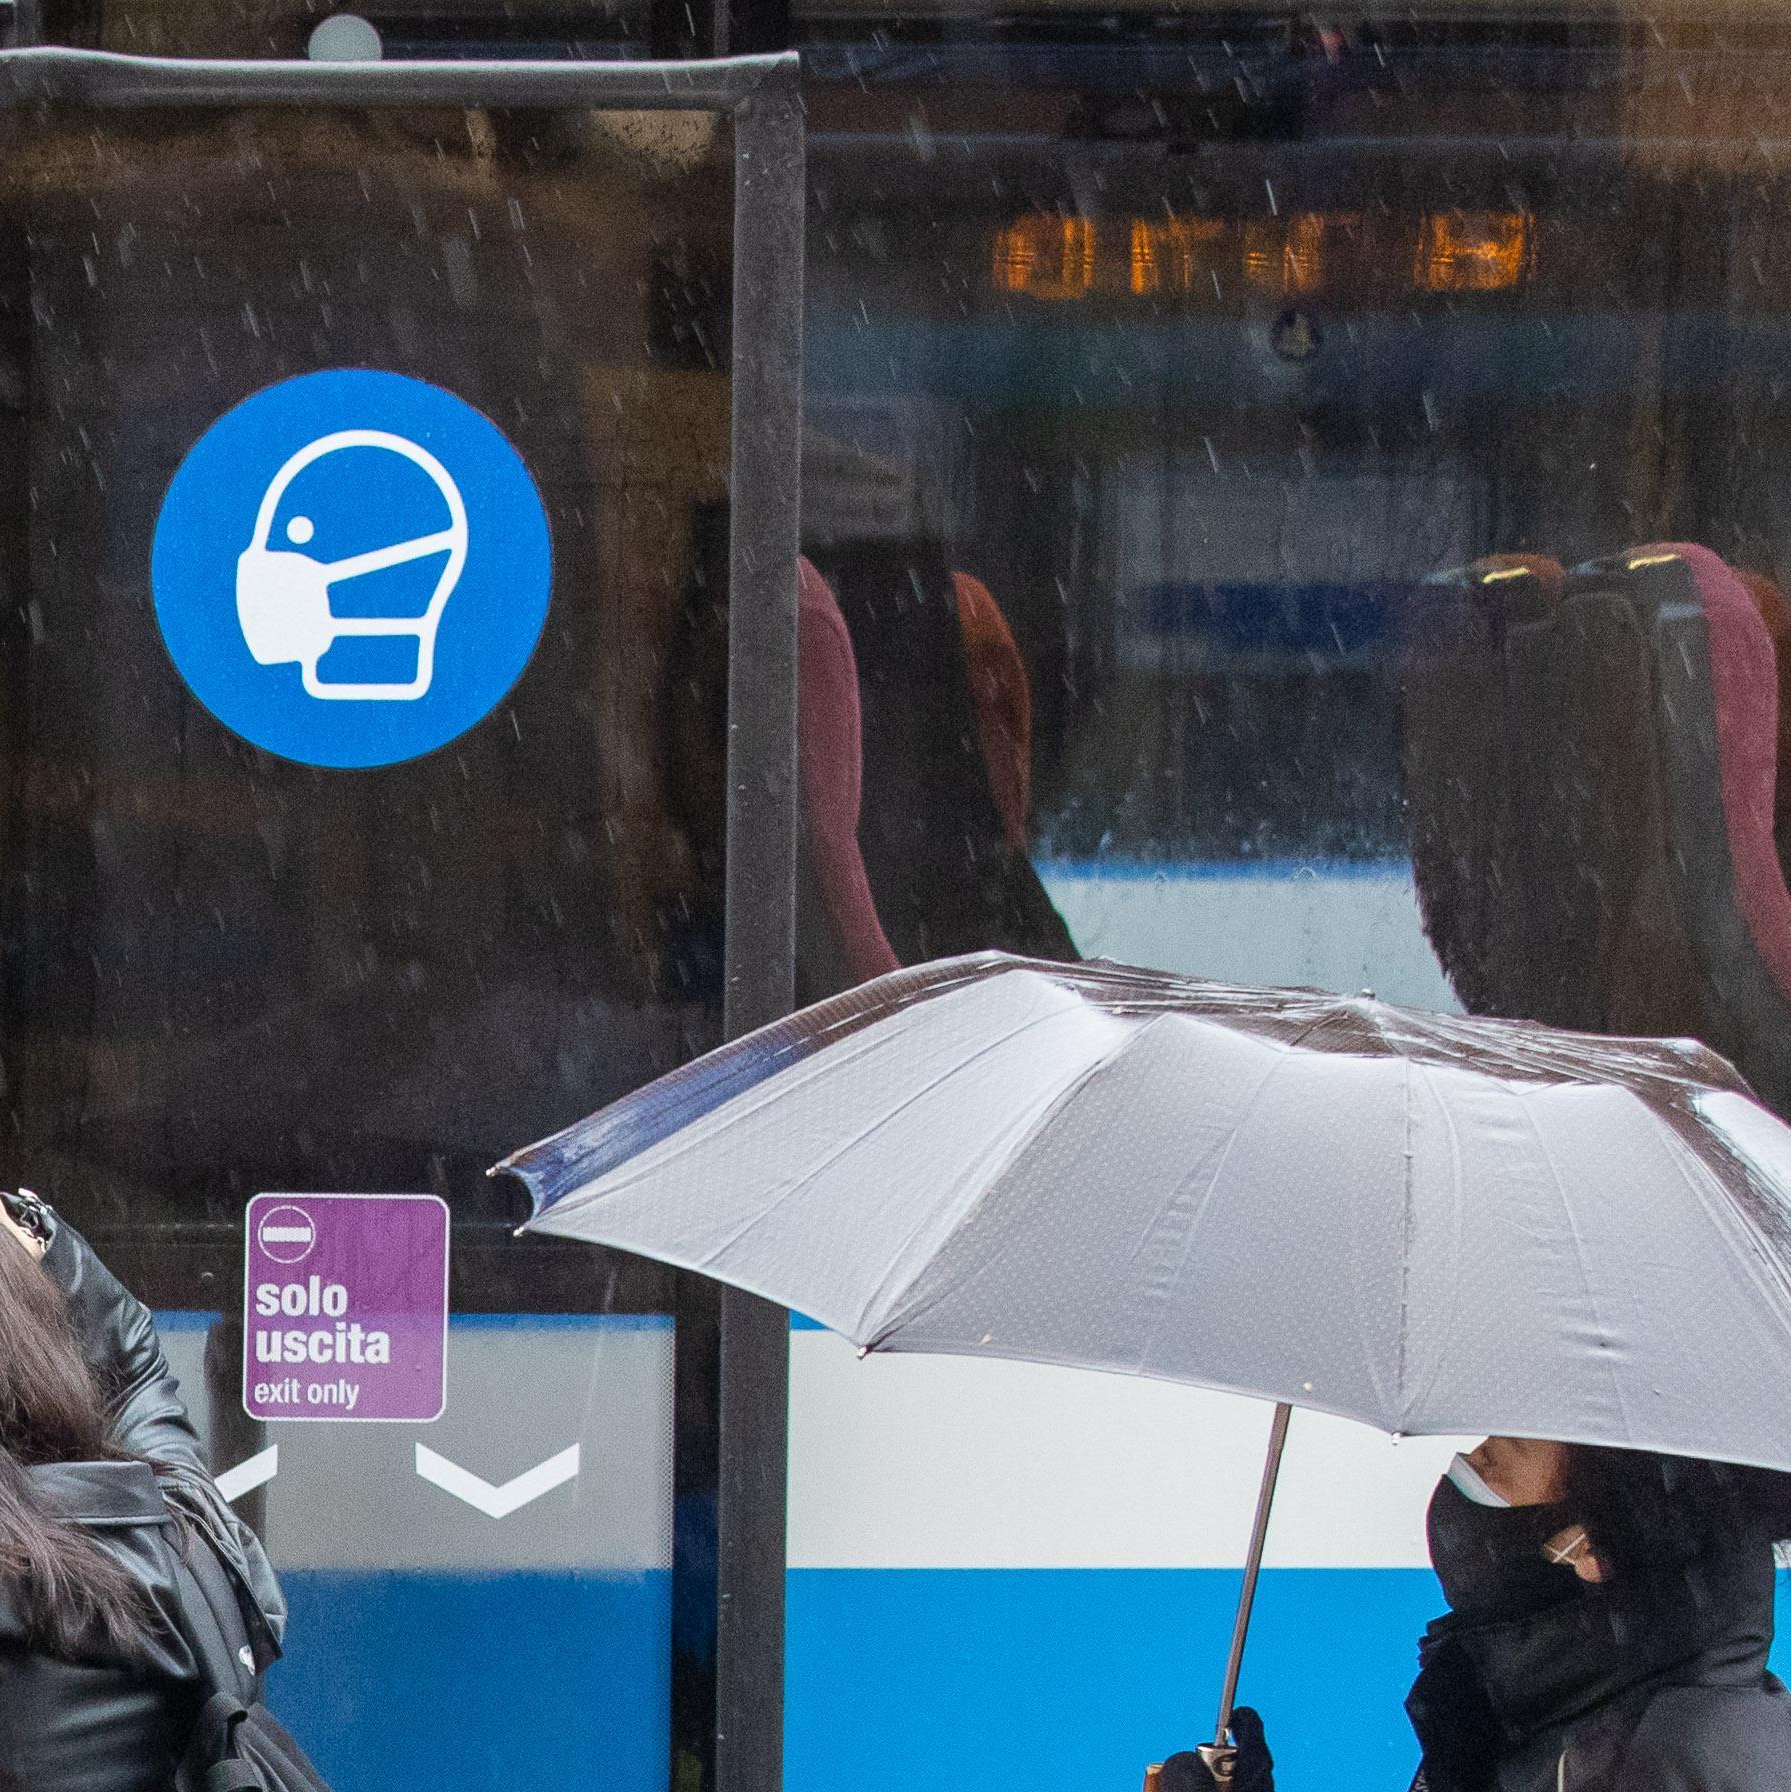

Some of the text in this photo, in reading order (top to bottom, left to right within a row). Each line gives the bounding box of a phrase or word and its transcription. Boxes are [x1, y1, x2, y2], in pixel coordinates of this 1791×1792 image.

[255, 1275, 348, 1317] solo
[254, 1322, 391, 1364] uscita
[254, 1378, 360, 1409] exit only
